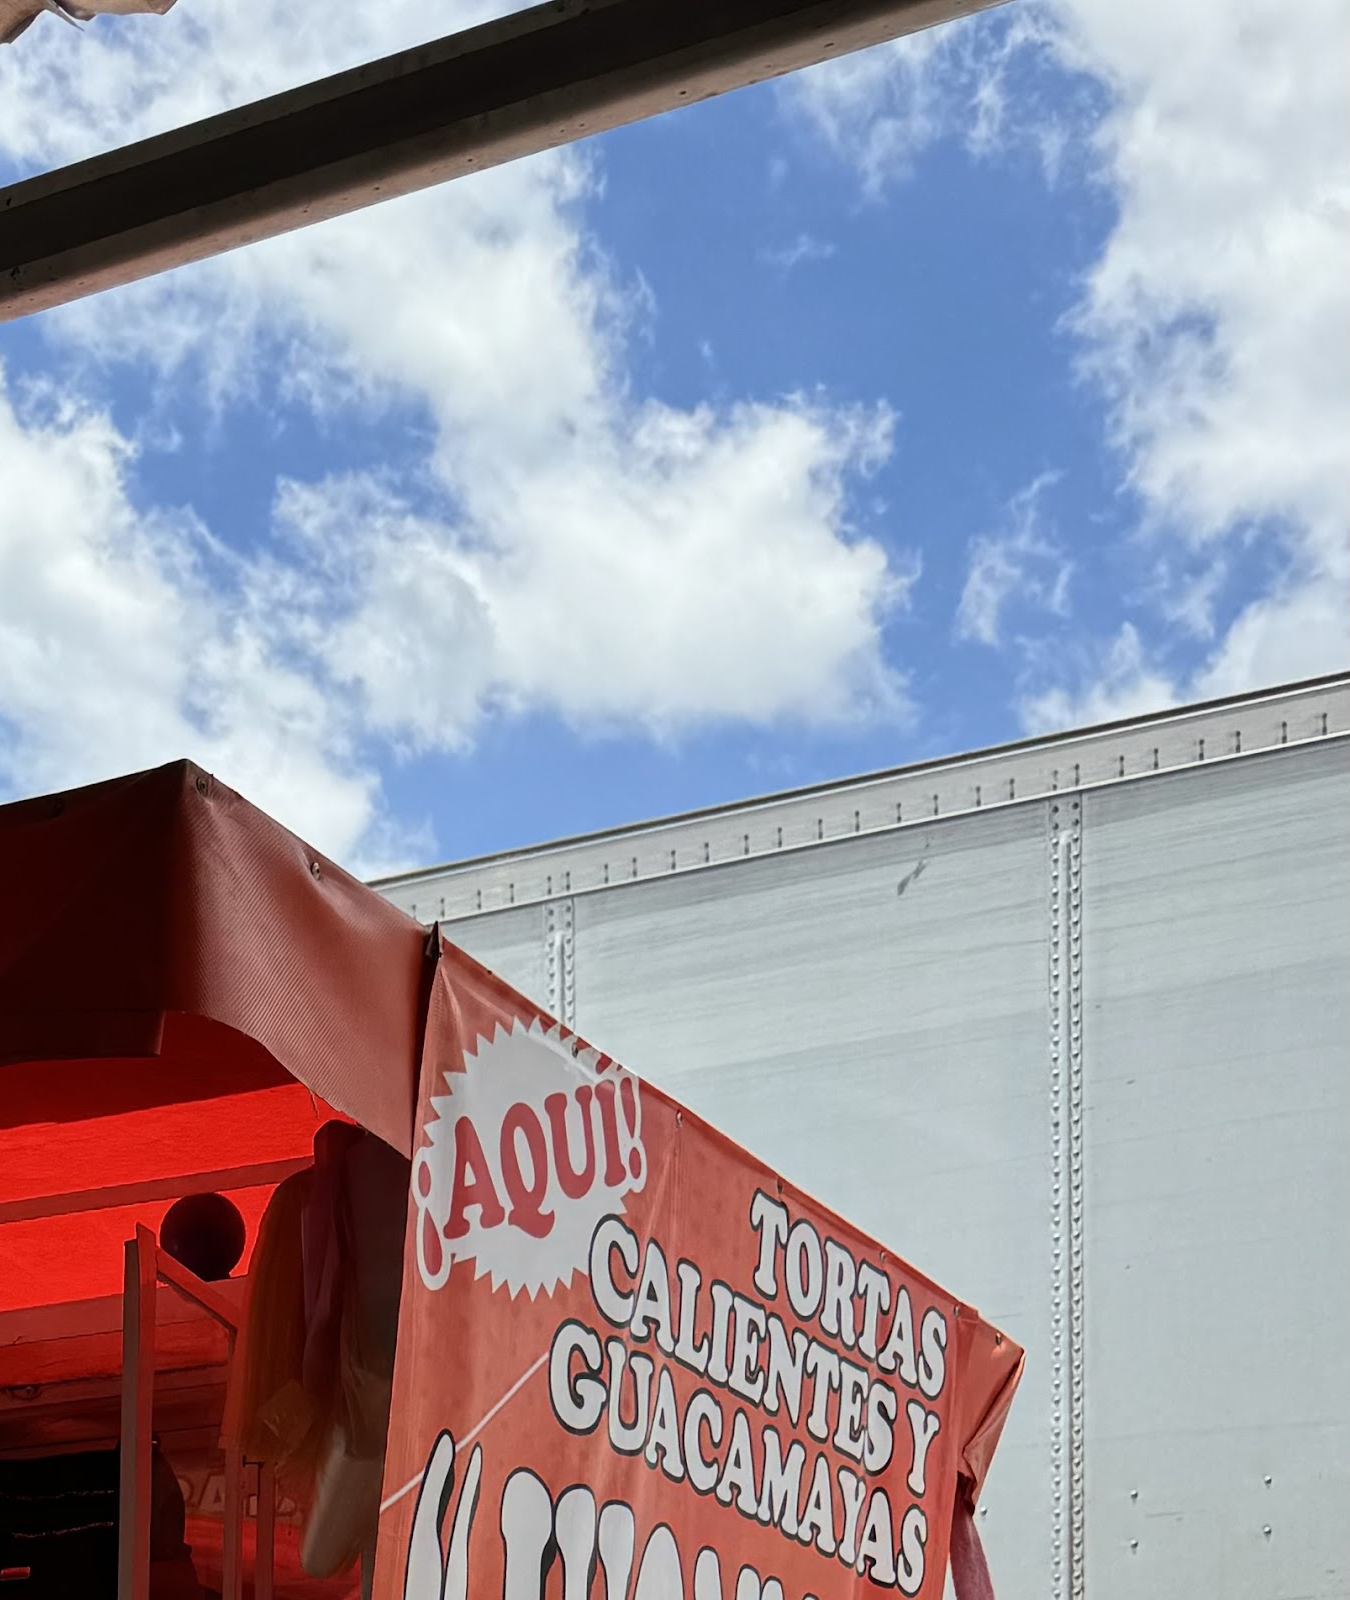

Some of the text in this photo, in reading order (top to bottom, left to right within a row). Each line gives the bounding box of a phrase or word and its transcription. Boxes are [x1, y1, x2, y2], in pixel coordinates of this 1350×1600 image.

[589, 1214, 940, 1497] CALIENTES Y
[751, 1189, 947, 1398] TORTAS
[549, 1319, 928, 1597] GUACAMAYAS
